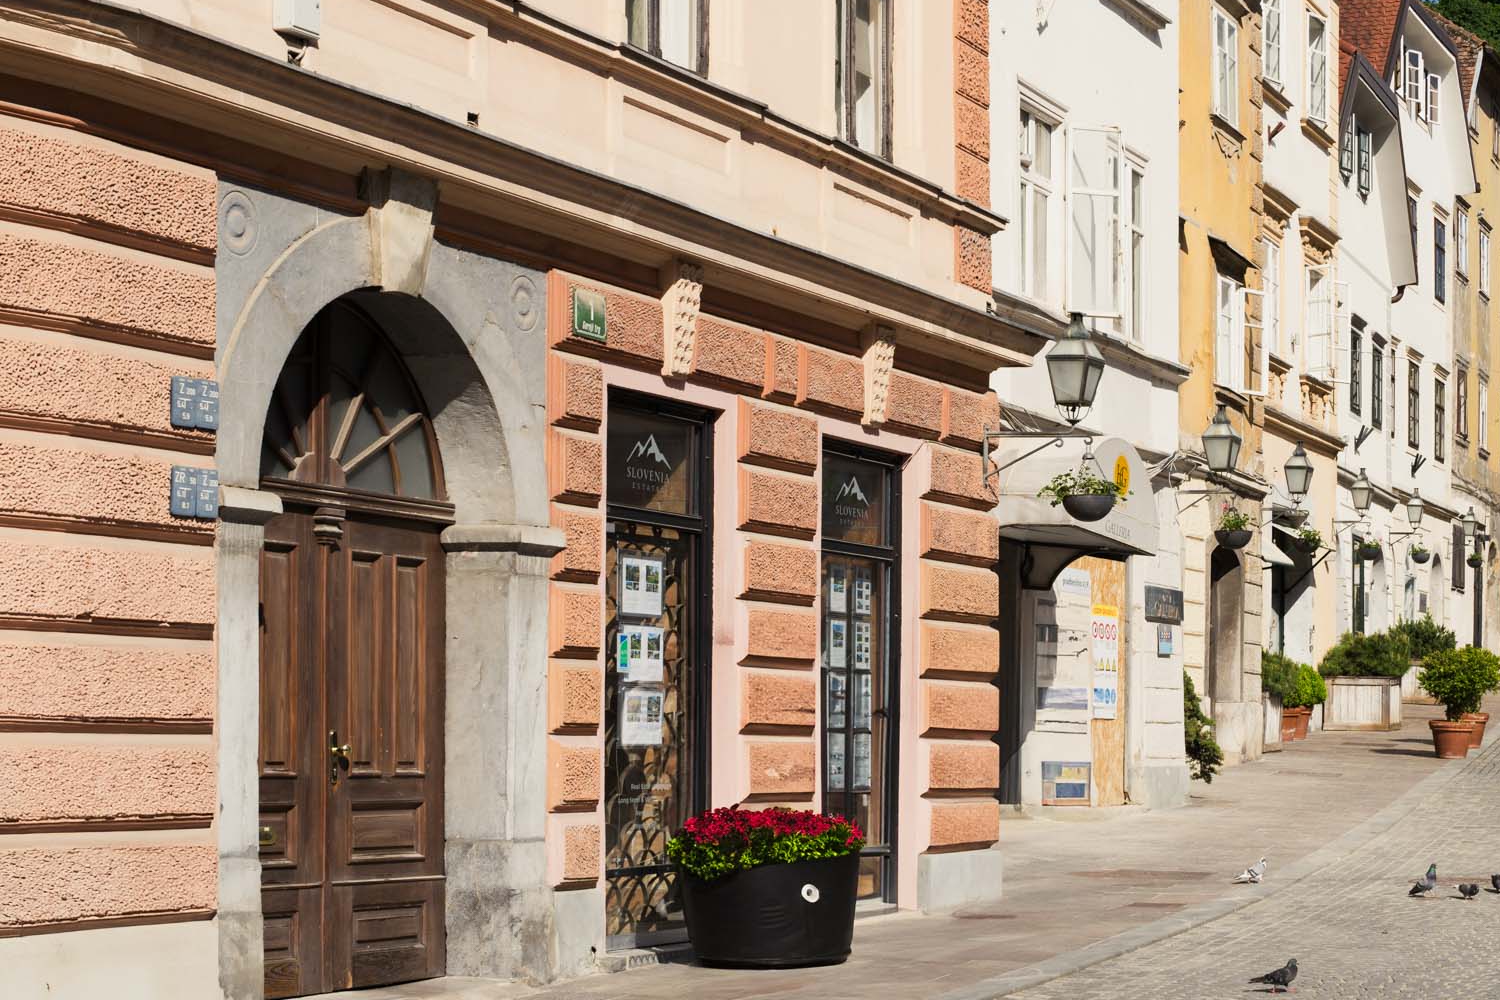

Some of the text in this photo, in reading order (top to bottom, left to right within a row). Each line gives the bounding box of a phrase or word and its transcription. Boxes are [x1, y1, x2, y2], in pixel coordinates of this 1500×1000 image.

[179, 382, 185, 394] Z
[202, 385, 208, 397] Z
[175, 471, 186, 484] ZR
[626, 466, 670, 484] SLOVENIA
[835, 504, 869, 520] SLOVENIA
